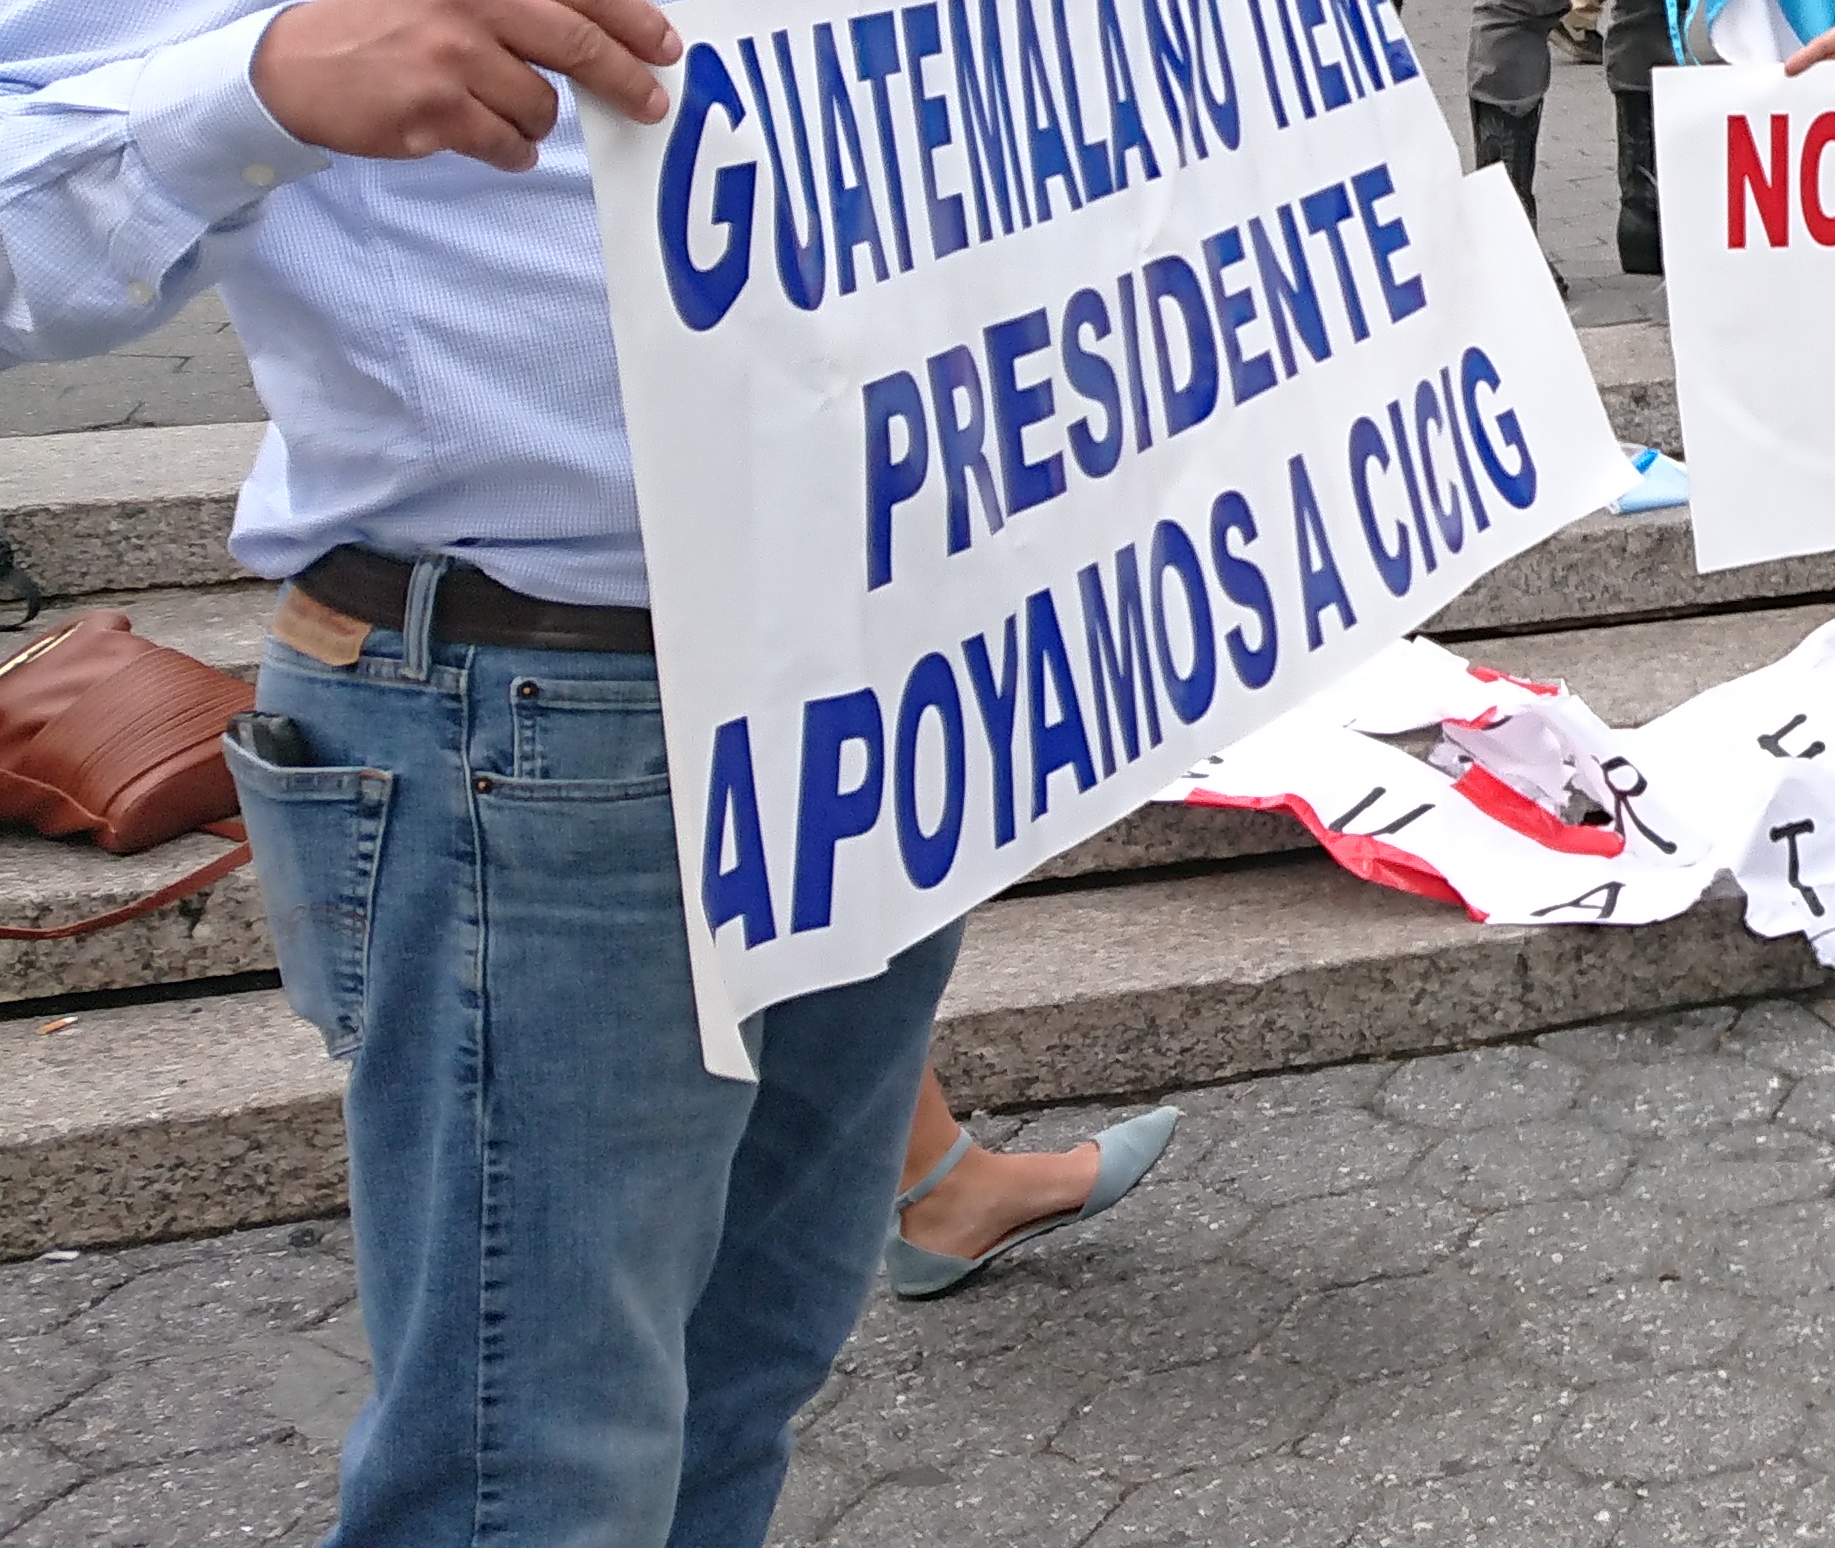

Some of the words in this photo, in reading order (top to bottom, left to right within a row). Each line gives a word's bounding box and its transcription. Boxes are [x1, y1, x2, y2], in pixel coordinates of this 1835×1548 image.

[863, 163, 1427, 592] PRESIDENTE
[701, 489, 1275, 948] APOYAMOS
[1288, 453, 1356, 652] A
[1348, 346, 1537, 600] CICIG
